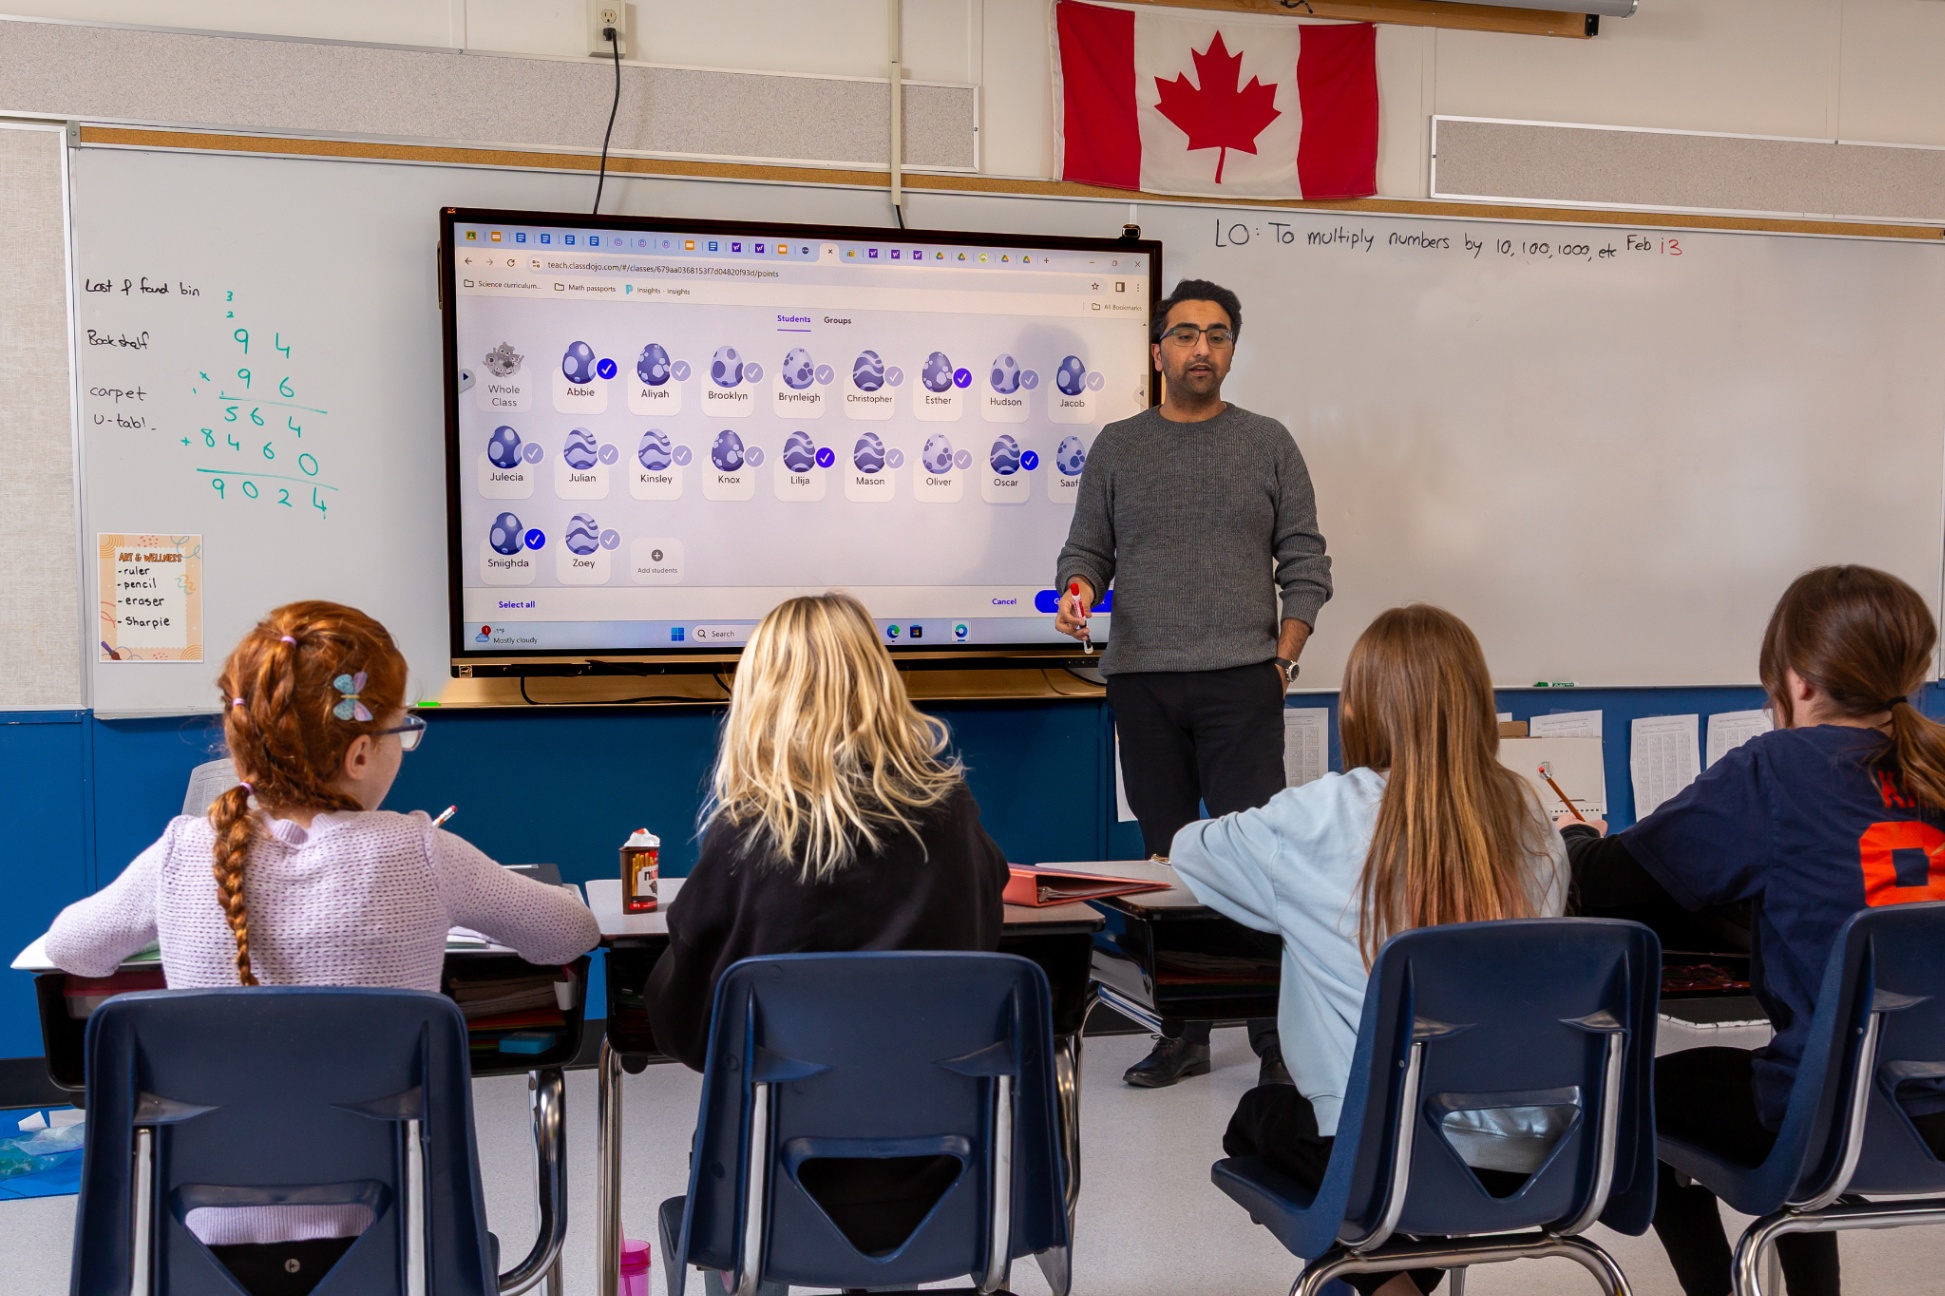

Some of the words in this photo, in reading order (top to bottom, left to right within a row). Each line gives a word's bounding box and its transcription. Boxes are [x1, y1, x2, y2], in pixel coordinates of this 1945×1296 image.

[1268, 222, 1295, 244] To
[1307, 226, 1374, 252] multiply
[1389, 231, 1450, 249] numbers
[1465, 232, 1483, 258] by
[1626, 234, 1651, 251] Feb
[85, 278, 113, 293] Lost
[180, 281, 200, 296] bin
[586, 285, 616, 293] passports
[667, 288, 691, 296] Insights
[777, 314, 812, 324] Students
[824, 316, 852, 326] Groups
[90, 386, 147, 404] carpet
[487, 385, 521, 395] Whole
[566, 386, 596, 397] Abbie
[640, 389, 670, 400] Aliyah
[707, 390, 749, 402] Brooklyn
[778, 392, 821, 404] Brynleigh
[846, 394, 893, 405] Christopher
[925, 396, 952, 406] Esther
[491, 397, 518, 408] Class
[990, 397, 1022, 407] Hudson
[1059, 399, 1086, 408] Jacob
[489, 472, 524, 483] Julecia
[568, 473, 597, 483] Julian
[640, 474, 673, 485] Kinsley
[717, 475, 741, 484] Knox
[790, 475, 811, 487] Lilija
[855, 476, 885, 486] Mason
[925, 477, 952, 487] Oliver
[993, 478, 1019, 488] Oscar
[118, 552, 134, 563] ART
[134, 553, 143, 563] &
[143, 553, 183, 563] WELLNESS
[487, 558, 530, 570] Sniighda
[572, 558, 596, 570] Zoey
[498, 600, 524, 608] Select
[525, 600, 536, 608] all
[992, 598, 1017, 606] Cancel
[711, 630, 735, 638] Search
[493, 637, 515, 645] Mostly
[516, 637, 538, 645] cloudy
